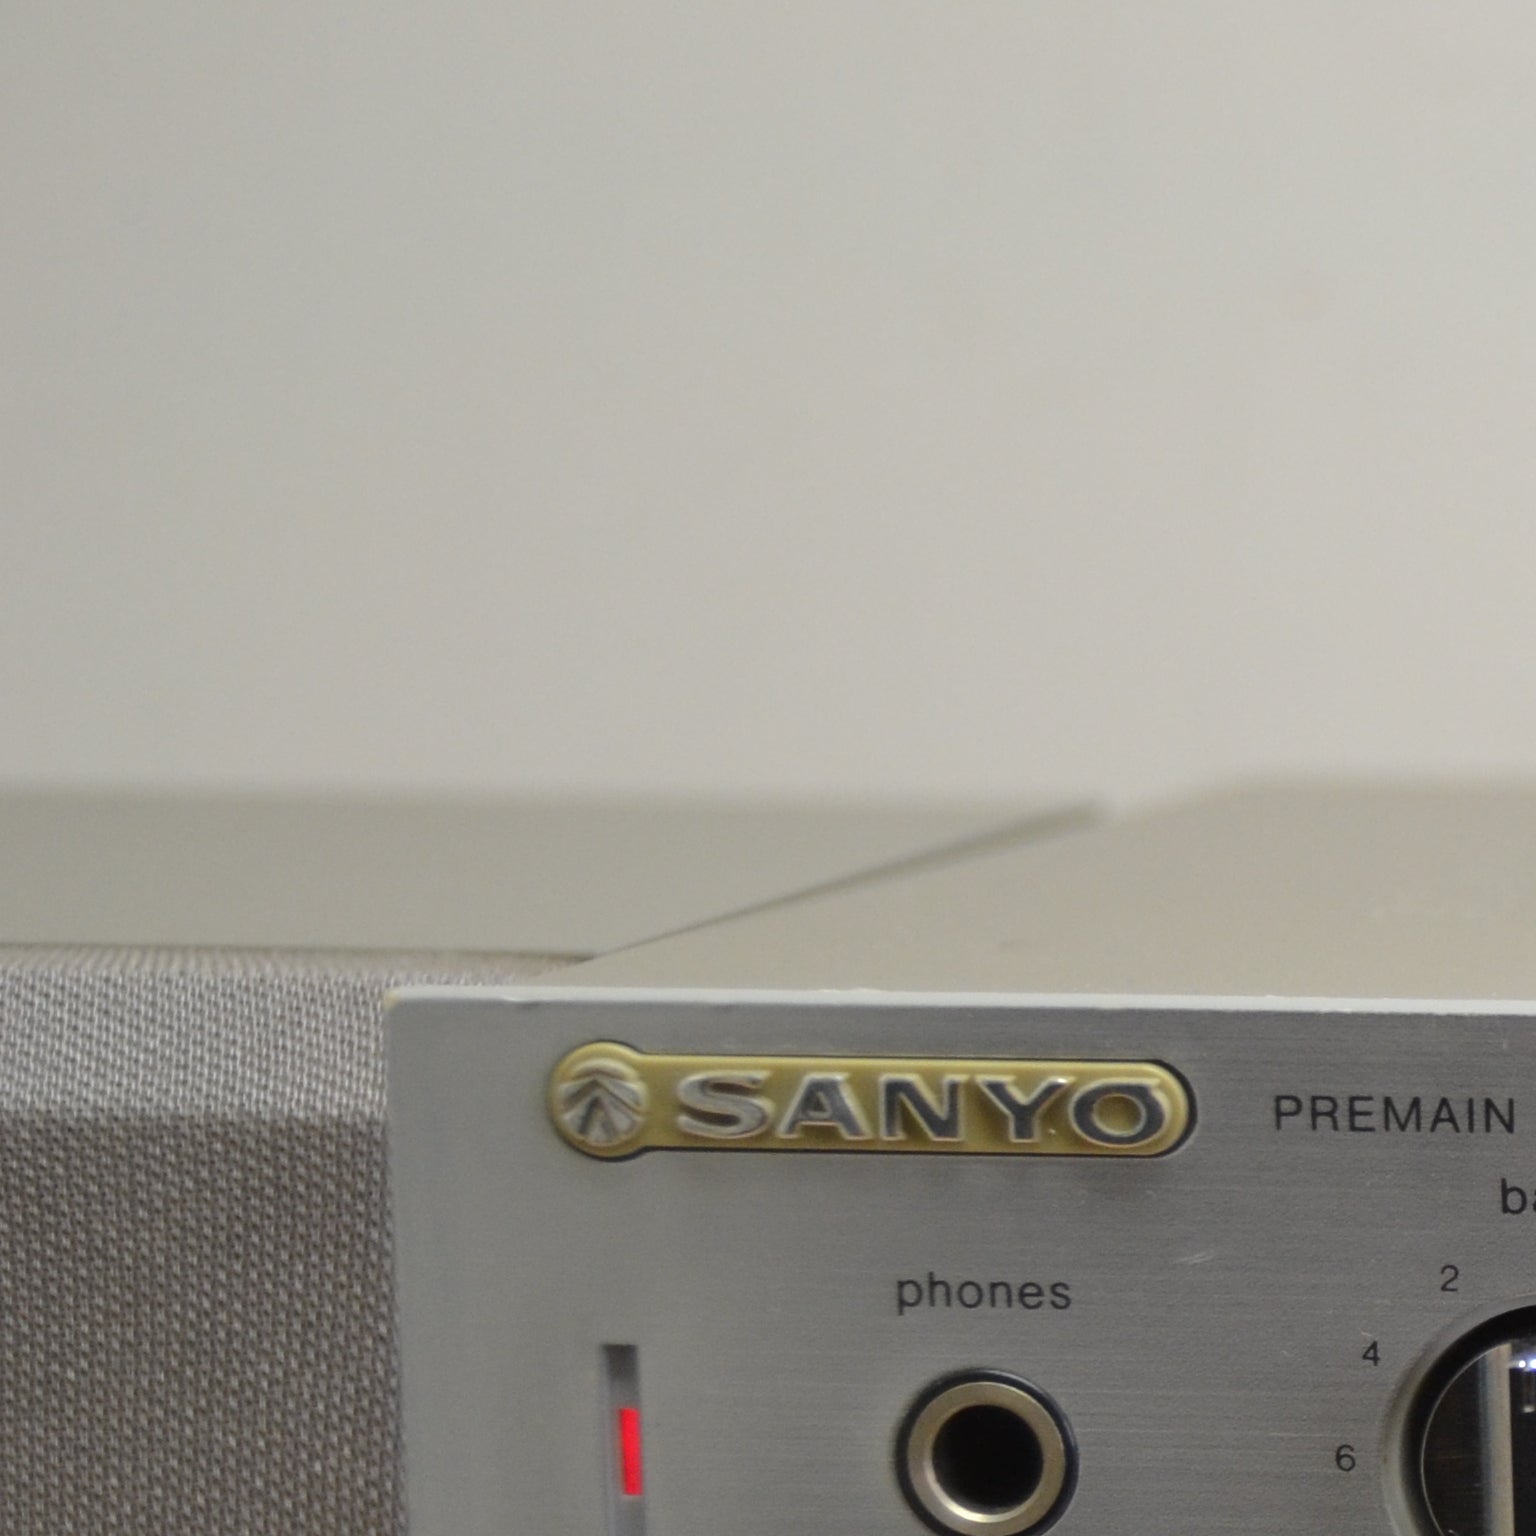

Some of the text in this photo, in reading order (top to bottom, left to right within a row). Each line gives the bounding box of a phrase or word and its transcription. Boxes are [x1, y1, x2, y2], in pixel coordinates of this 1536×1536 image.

[676, 1072, 1166, 1148] SANYO
[1273, 1094, 1515, 1134] PREMAIN
[896, 1271, 1072, 1316] phones
[1440, 1263, 1460, 1293] 2
[1361, 1340, 1381, 1367] 4
[1334, 1443, 1357, 1473] 6
